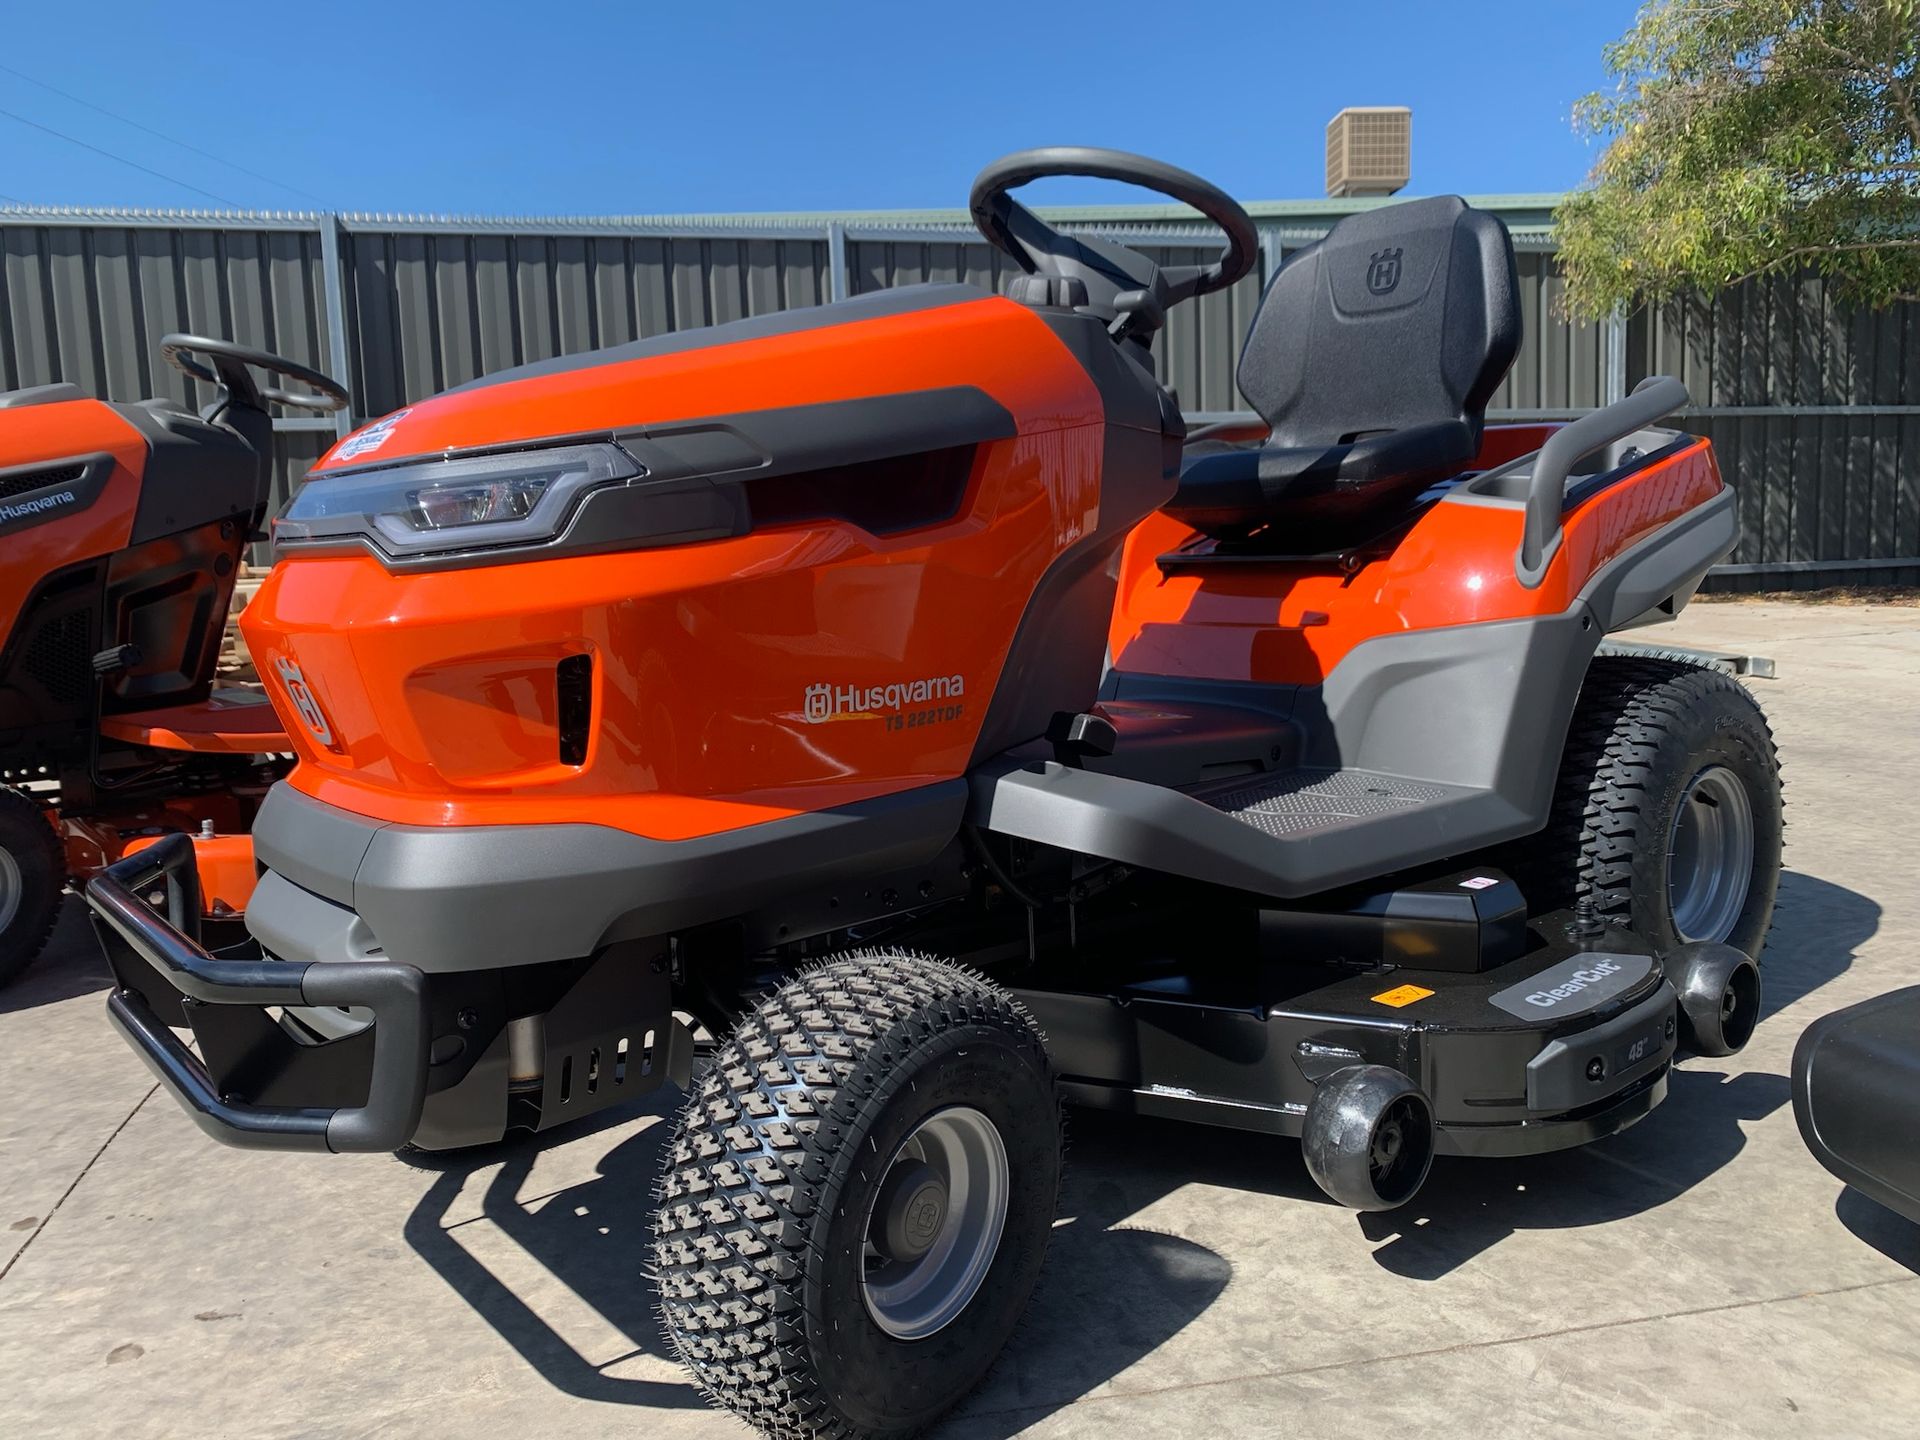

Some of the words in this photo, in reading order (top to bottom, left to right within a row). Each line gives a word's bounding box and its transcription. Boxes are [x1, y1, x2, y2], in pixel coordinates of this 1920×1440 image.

[0, 491, 75, 520] Husqvarna
[835, 674, 964, 712] Husqvarna
[886, 715, 904, 732] TS
[1525, 958, 1622, 1008] ClearCut
